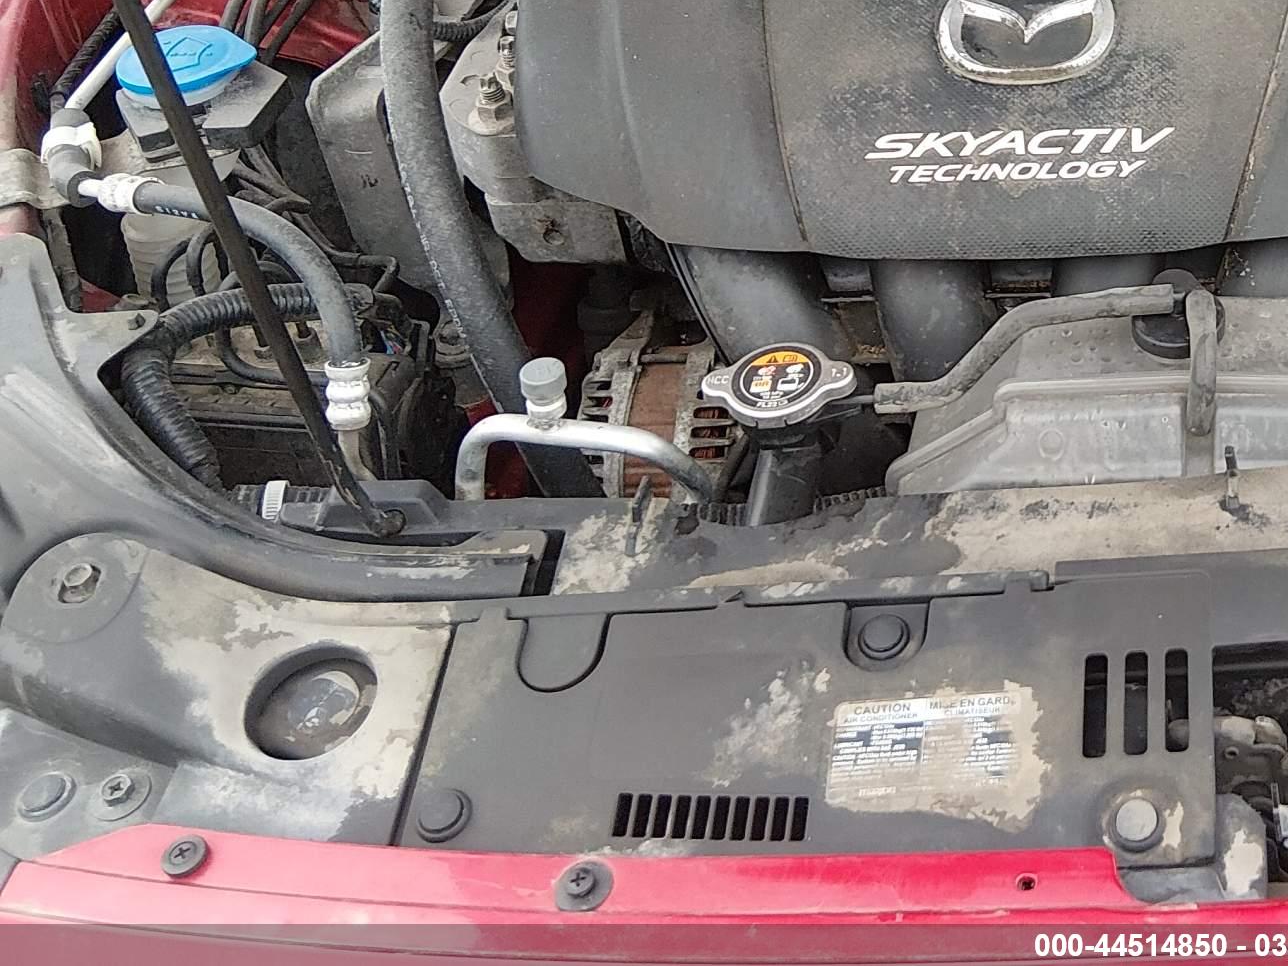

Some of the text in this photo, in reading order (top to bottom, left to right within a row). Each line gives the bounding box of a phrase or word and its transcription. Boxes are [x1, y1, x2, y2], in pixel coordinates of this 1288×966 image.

[864, 126, 1176, 160] SKYACTIV
[889, 159, 1147, 184] TECHNOLOGY
[959, 697, 975, 708] EN
[977, 695, 1016, 707] GARD
[854, 703, 911, 715] CAUTION
[844, 713, 918, 724] AIR CONDITIONER
